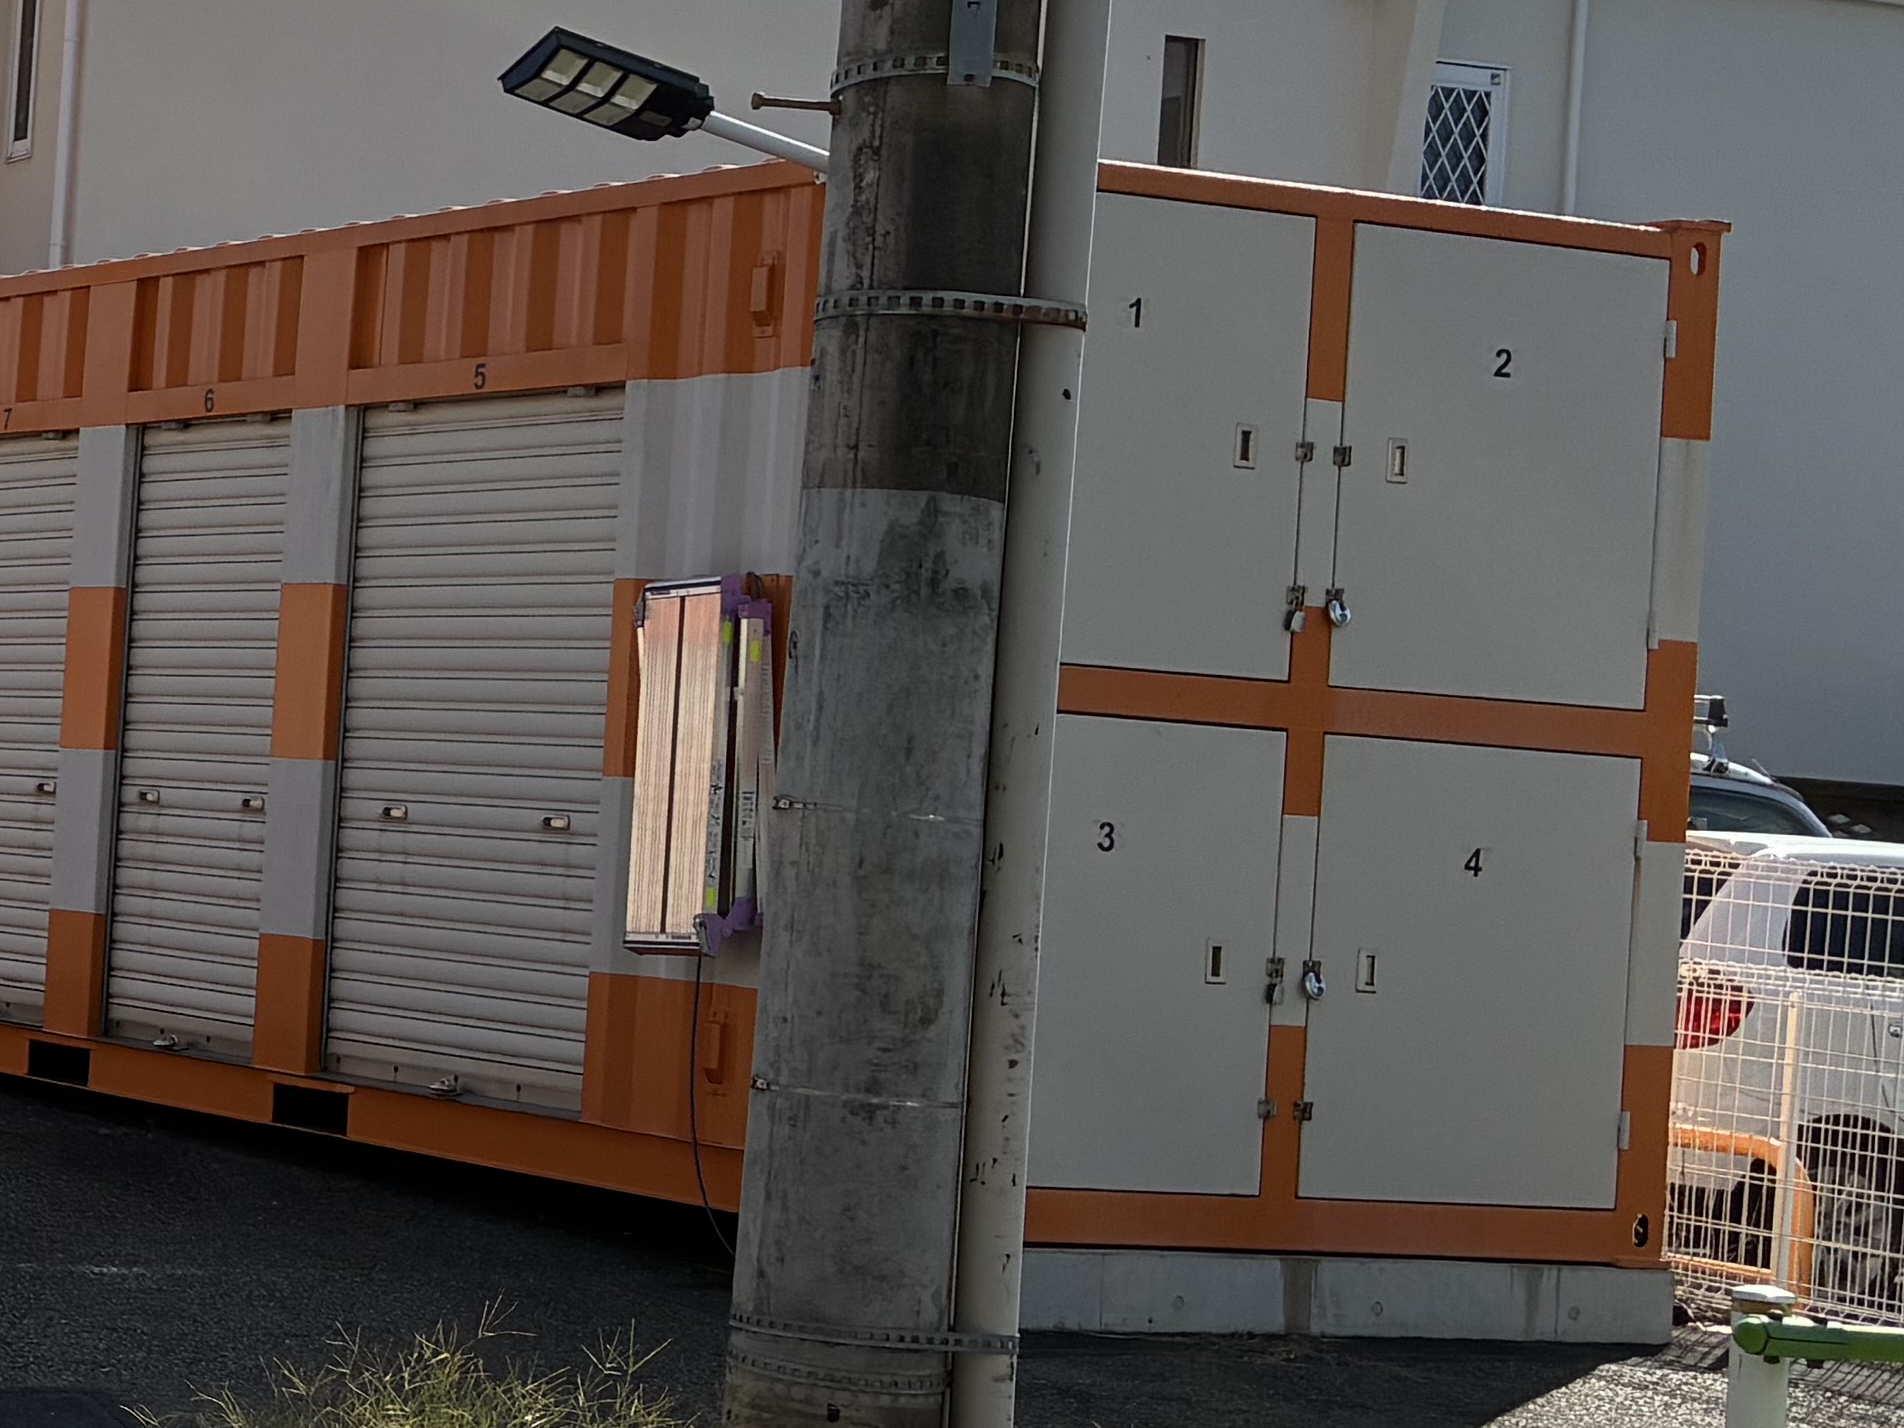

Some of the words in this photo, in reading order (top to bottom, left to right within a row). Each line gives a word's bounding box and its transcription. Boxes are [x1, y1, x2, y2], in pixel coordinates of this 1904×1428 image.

[1129, 297, 1142, 328] 1
[474, 363, 487, 390] 5
[1493, 348, 1512, 378] 2
[204, 389, 214, 413] 6
[3, 408, 13, 430] 7
[1097, 821, 1114, 852] 3
[1464, 847, 1483, 878] 4
